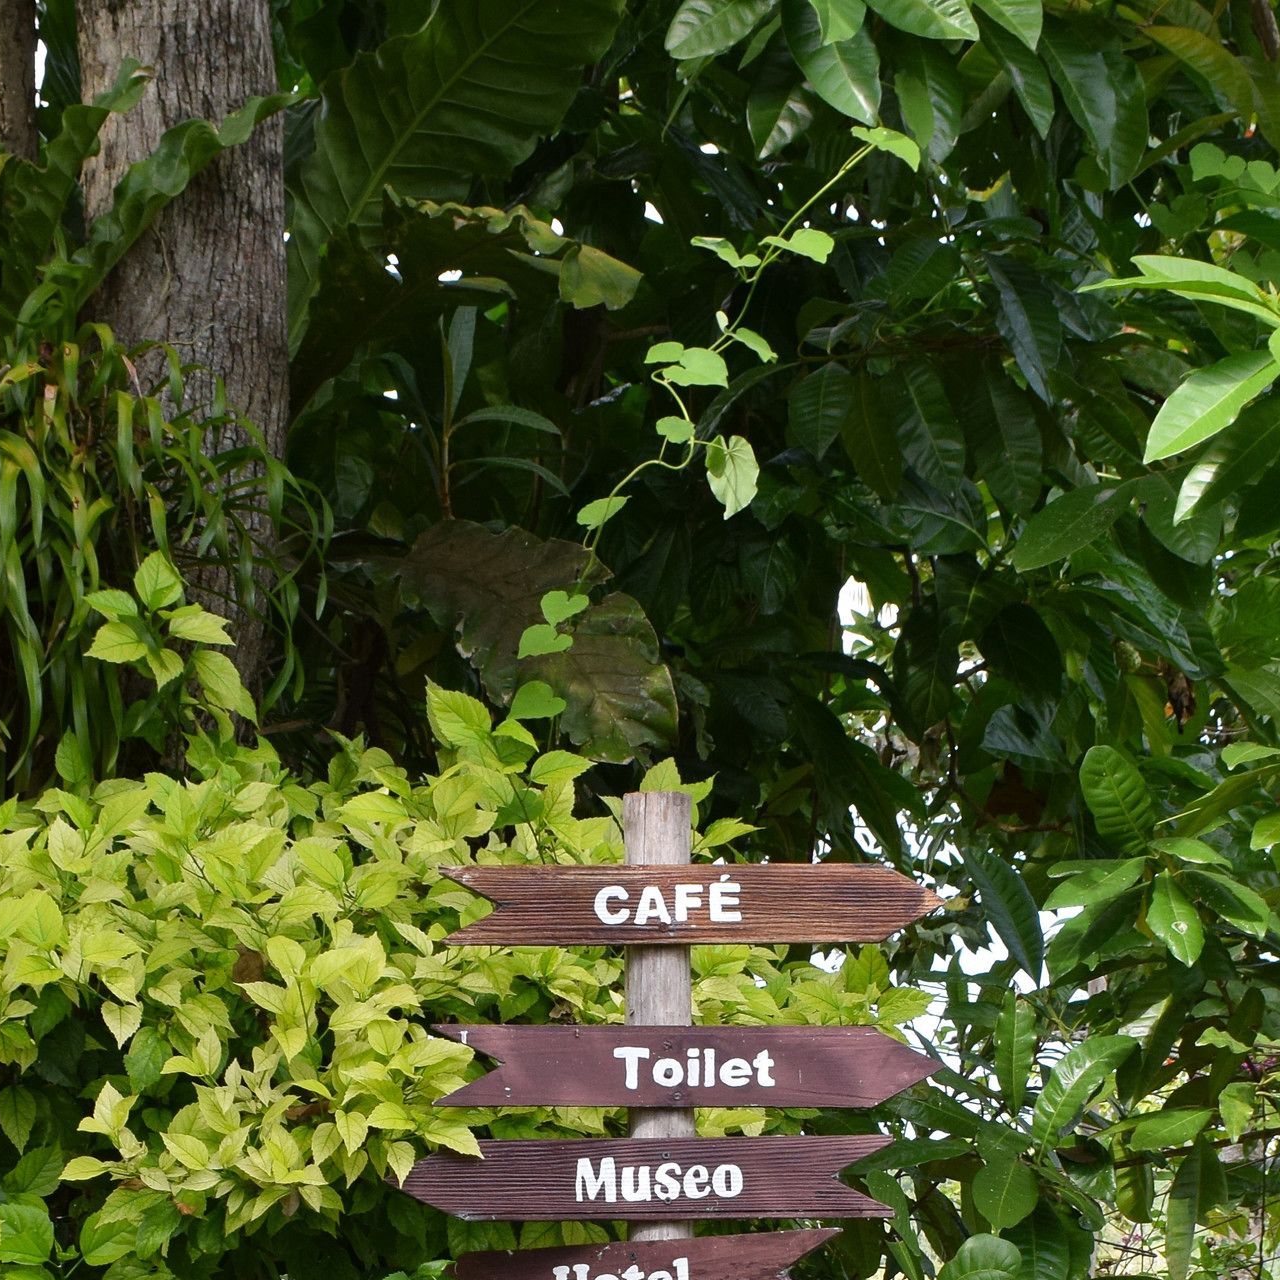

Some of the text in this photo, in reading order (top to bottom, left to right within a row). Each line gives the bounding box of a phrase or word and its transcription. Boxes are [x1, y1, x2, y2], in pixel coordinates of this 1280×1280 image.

[593, 874, 743, 926] CAFÉ
[613, 1047, 776, 1090] Toilet
[575, 1156, 745, 1203] Museo
